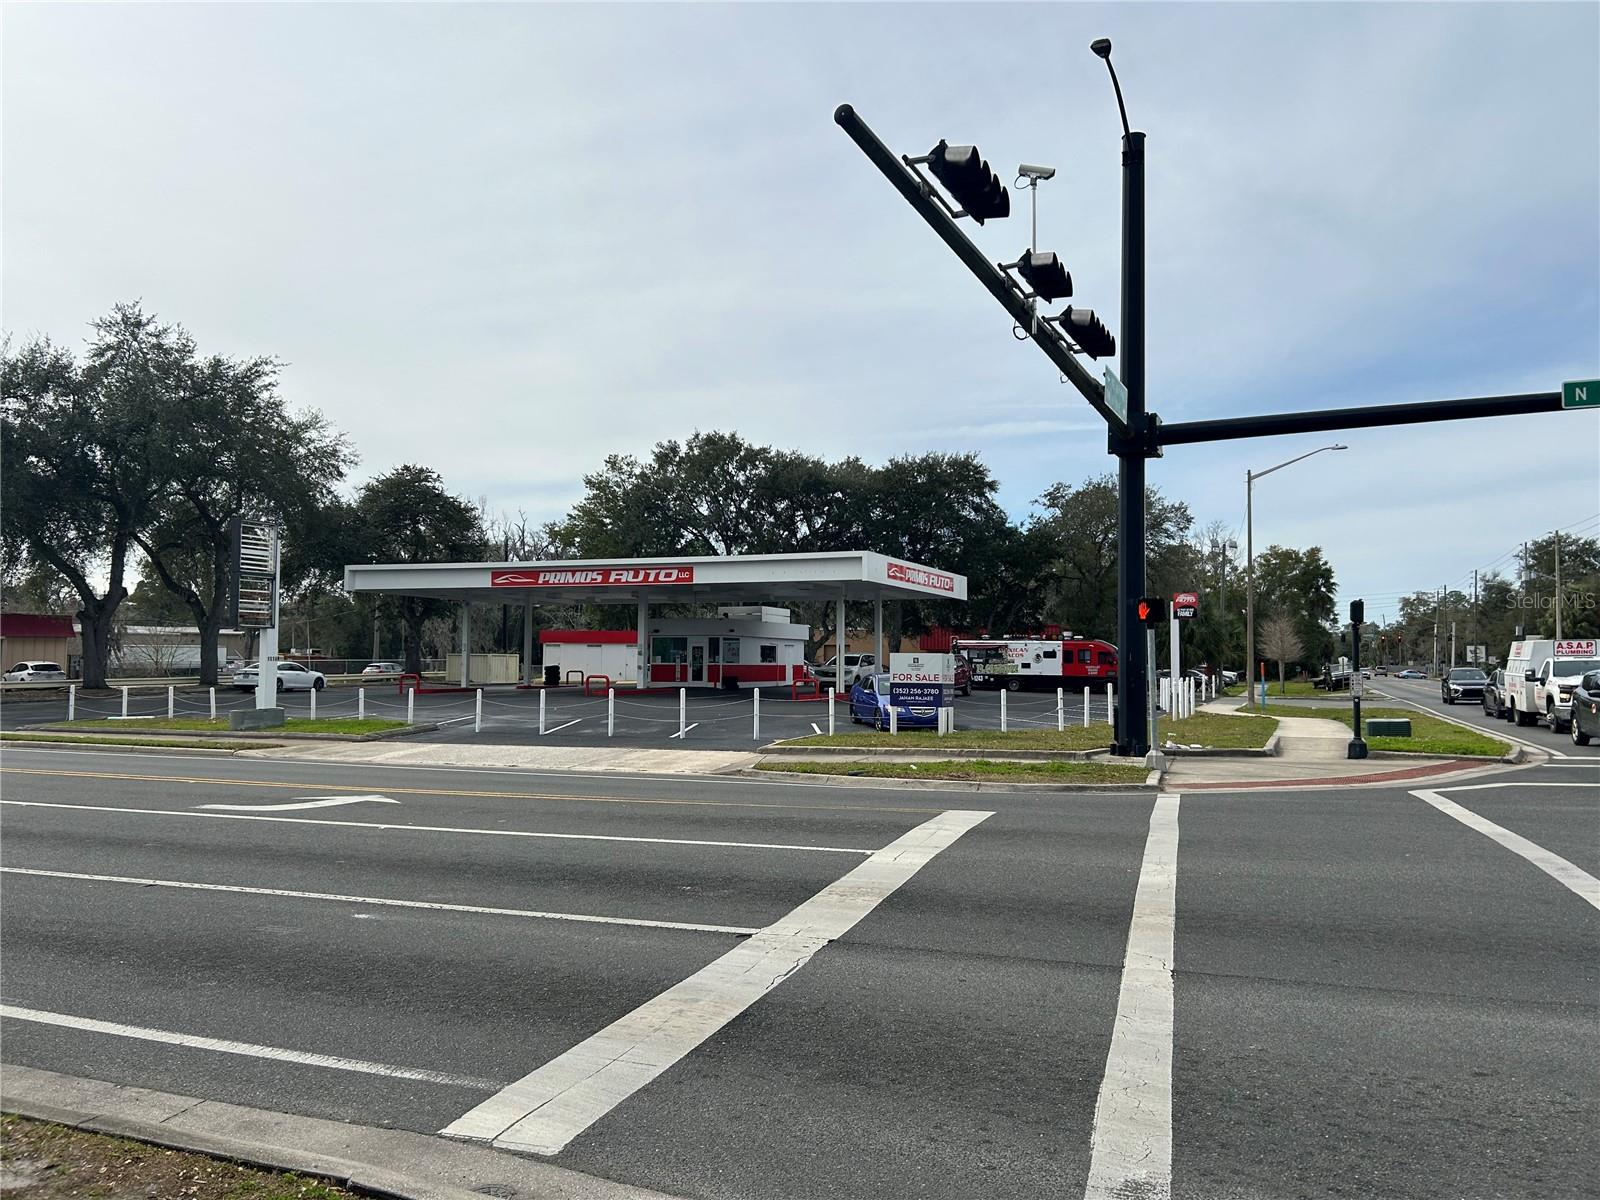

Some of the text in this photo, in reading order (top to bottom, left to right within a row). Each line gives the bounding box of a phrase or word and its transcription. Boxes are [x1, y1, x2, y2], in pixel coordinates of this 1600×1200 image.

[1575, 387, 1587, 401] N
[538, 570, 604, 584] PRIMOS
[609, 569, 679, 583] AUTO
[905, 569, 928, 585] PRIMOS
[929, 574, 950, 589] AUTO
[892, 673, 913, 682] FOR
[915, 673, 940, 682] SALE
[892, 687, 909, 695] (352)
